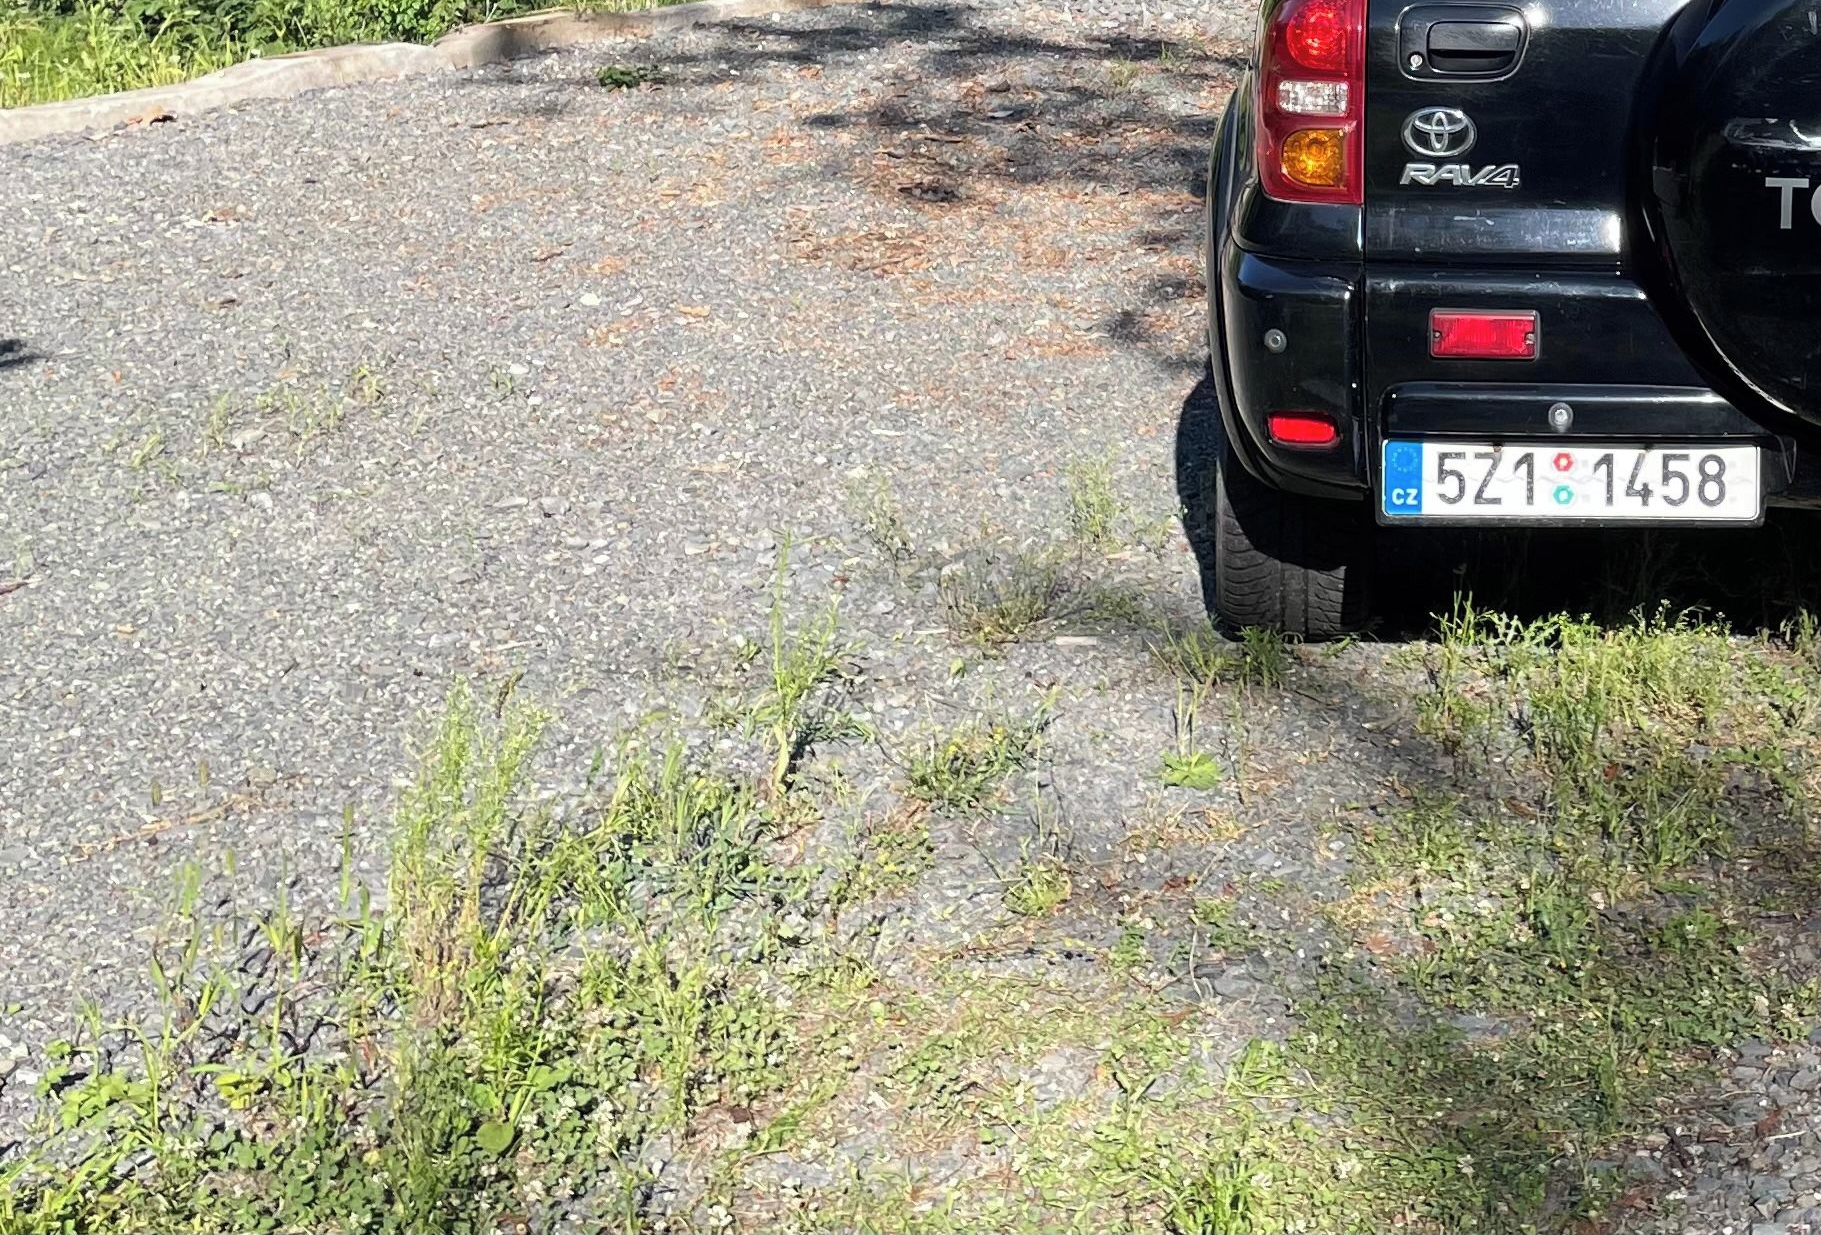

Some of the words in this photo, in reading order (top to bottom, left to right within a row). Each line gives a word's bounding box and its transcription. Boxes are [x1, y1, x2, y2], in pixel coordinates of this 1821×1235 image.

[1400, 164, 1520, 188] RAV4
[1437, 452, 1534, 506] 5Z1
[1593, 453, 1727, 507] 1458
[1392, 487, 1419, 506] CZ
